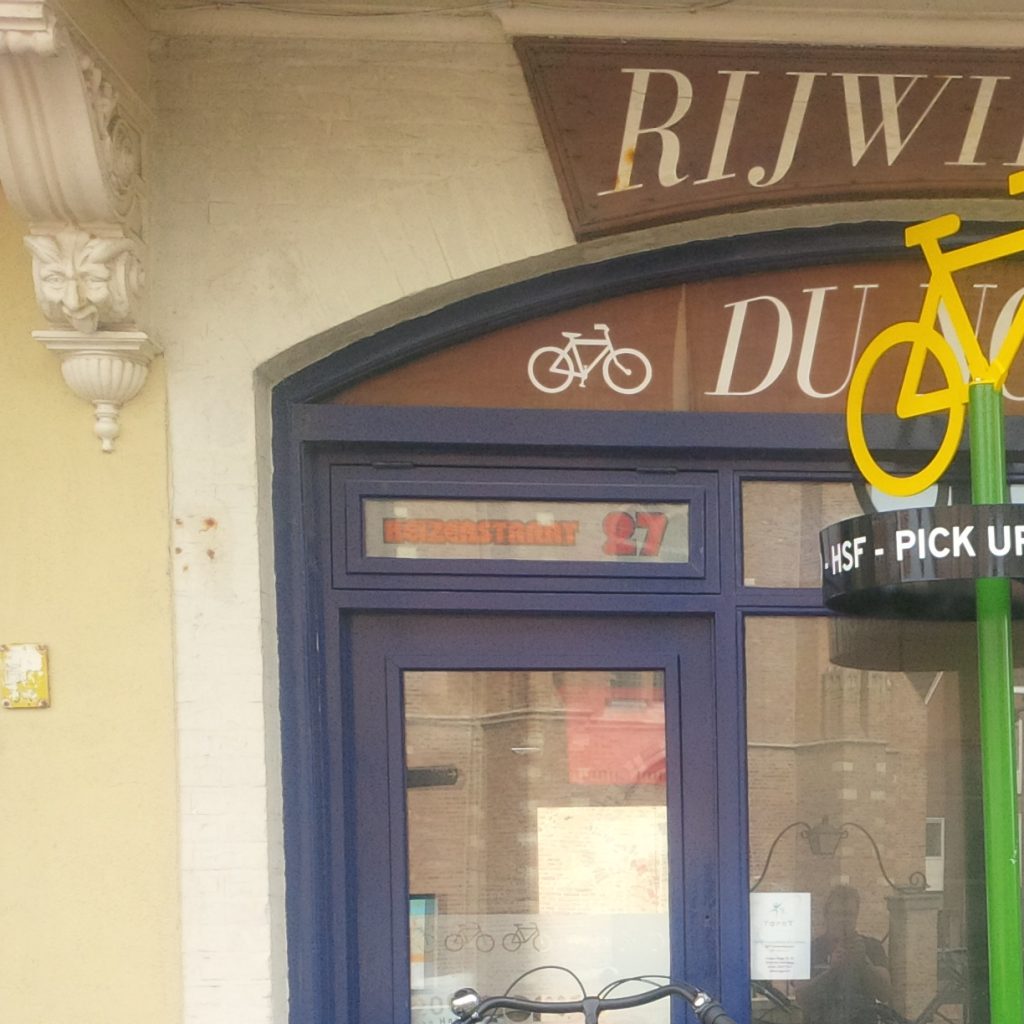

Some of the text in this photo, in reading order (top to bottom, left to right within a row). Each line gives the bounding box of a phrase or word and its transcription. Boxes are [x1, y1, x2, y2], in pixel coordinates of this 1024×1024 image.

[704, 284, 879, 399] DU
[602, 511, 668, 557] 27
[831, 536, 866, 575] HSF
[896, 525, 975, 561] PICK
